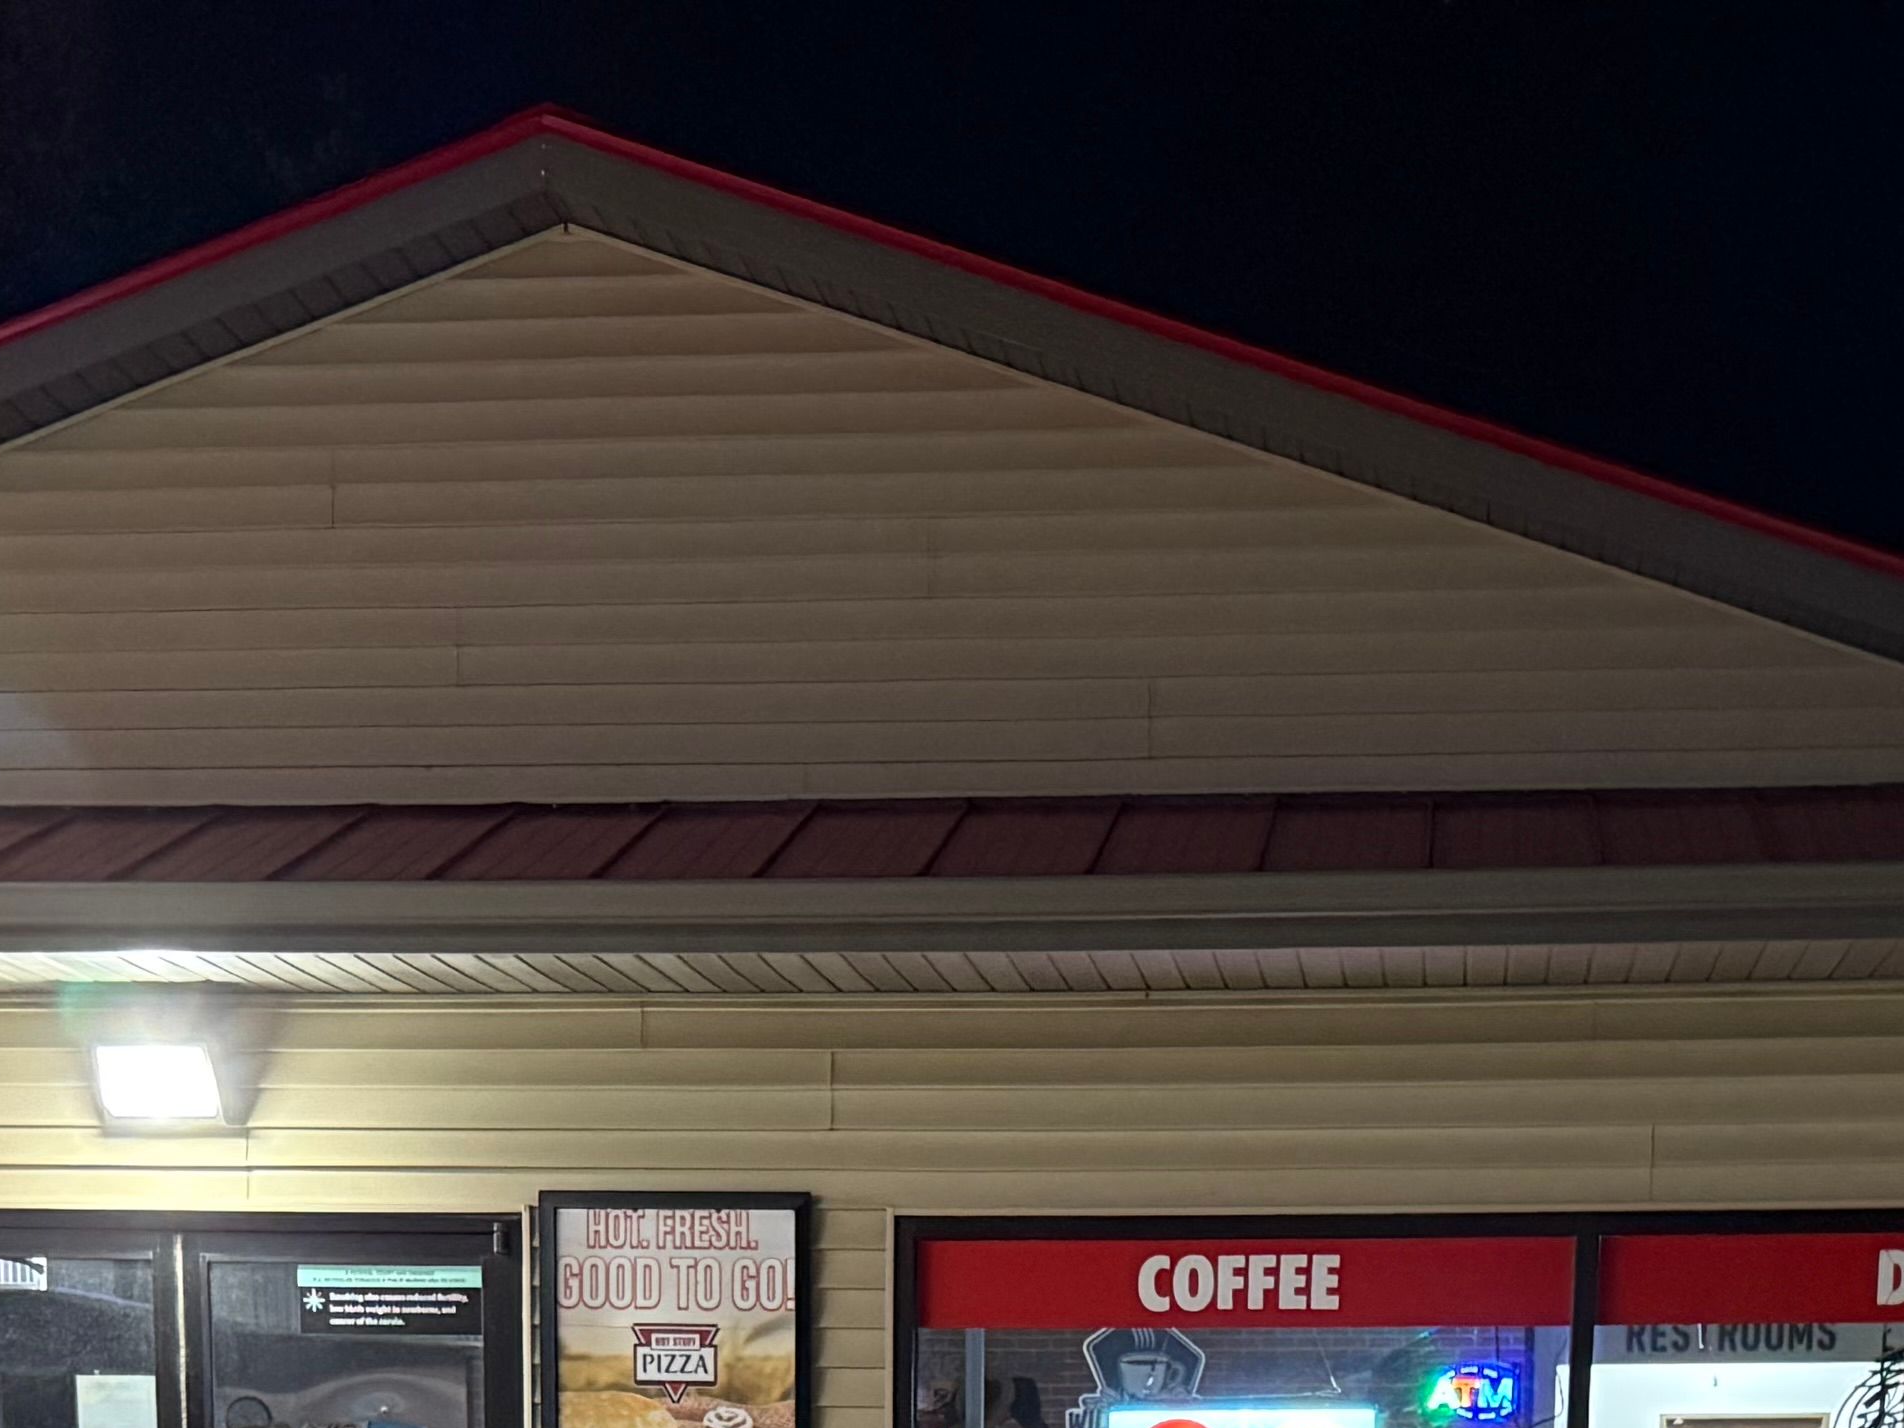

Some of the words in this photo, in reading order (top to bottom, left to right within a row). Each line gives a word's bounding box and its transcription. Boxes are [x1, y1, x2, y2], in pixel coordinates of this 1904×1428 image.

[587, 1208, 649, 1249] HOT.
[657, 1208, 758, 1250] FRESH.
[557, 1256, 662, 1310] GOOD
[670, 1257, 722, 1311] TO
[732, 1257, 795, 1311] GO!
[1137, 1254, 1341, 1313] COFFEE
[642, 1353, 709, 1374] PIZZA
[1427, 1375, 1513, 1409] ATM
